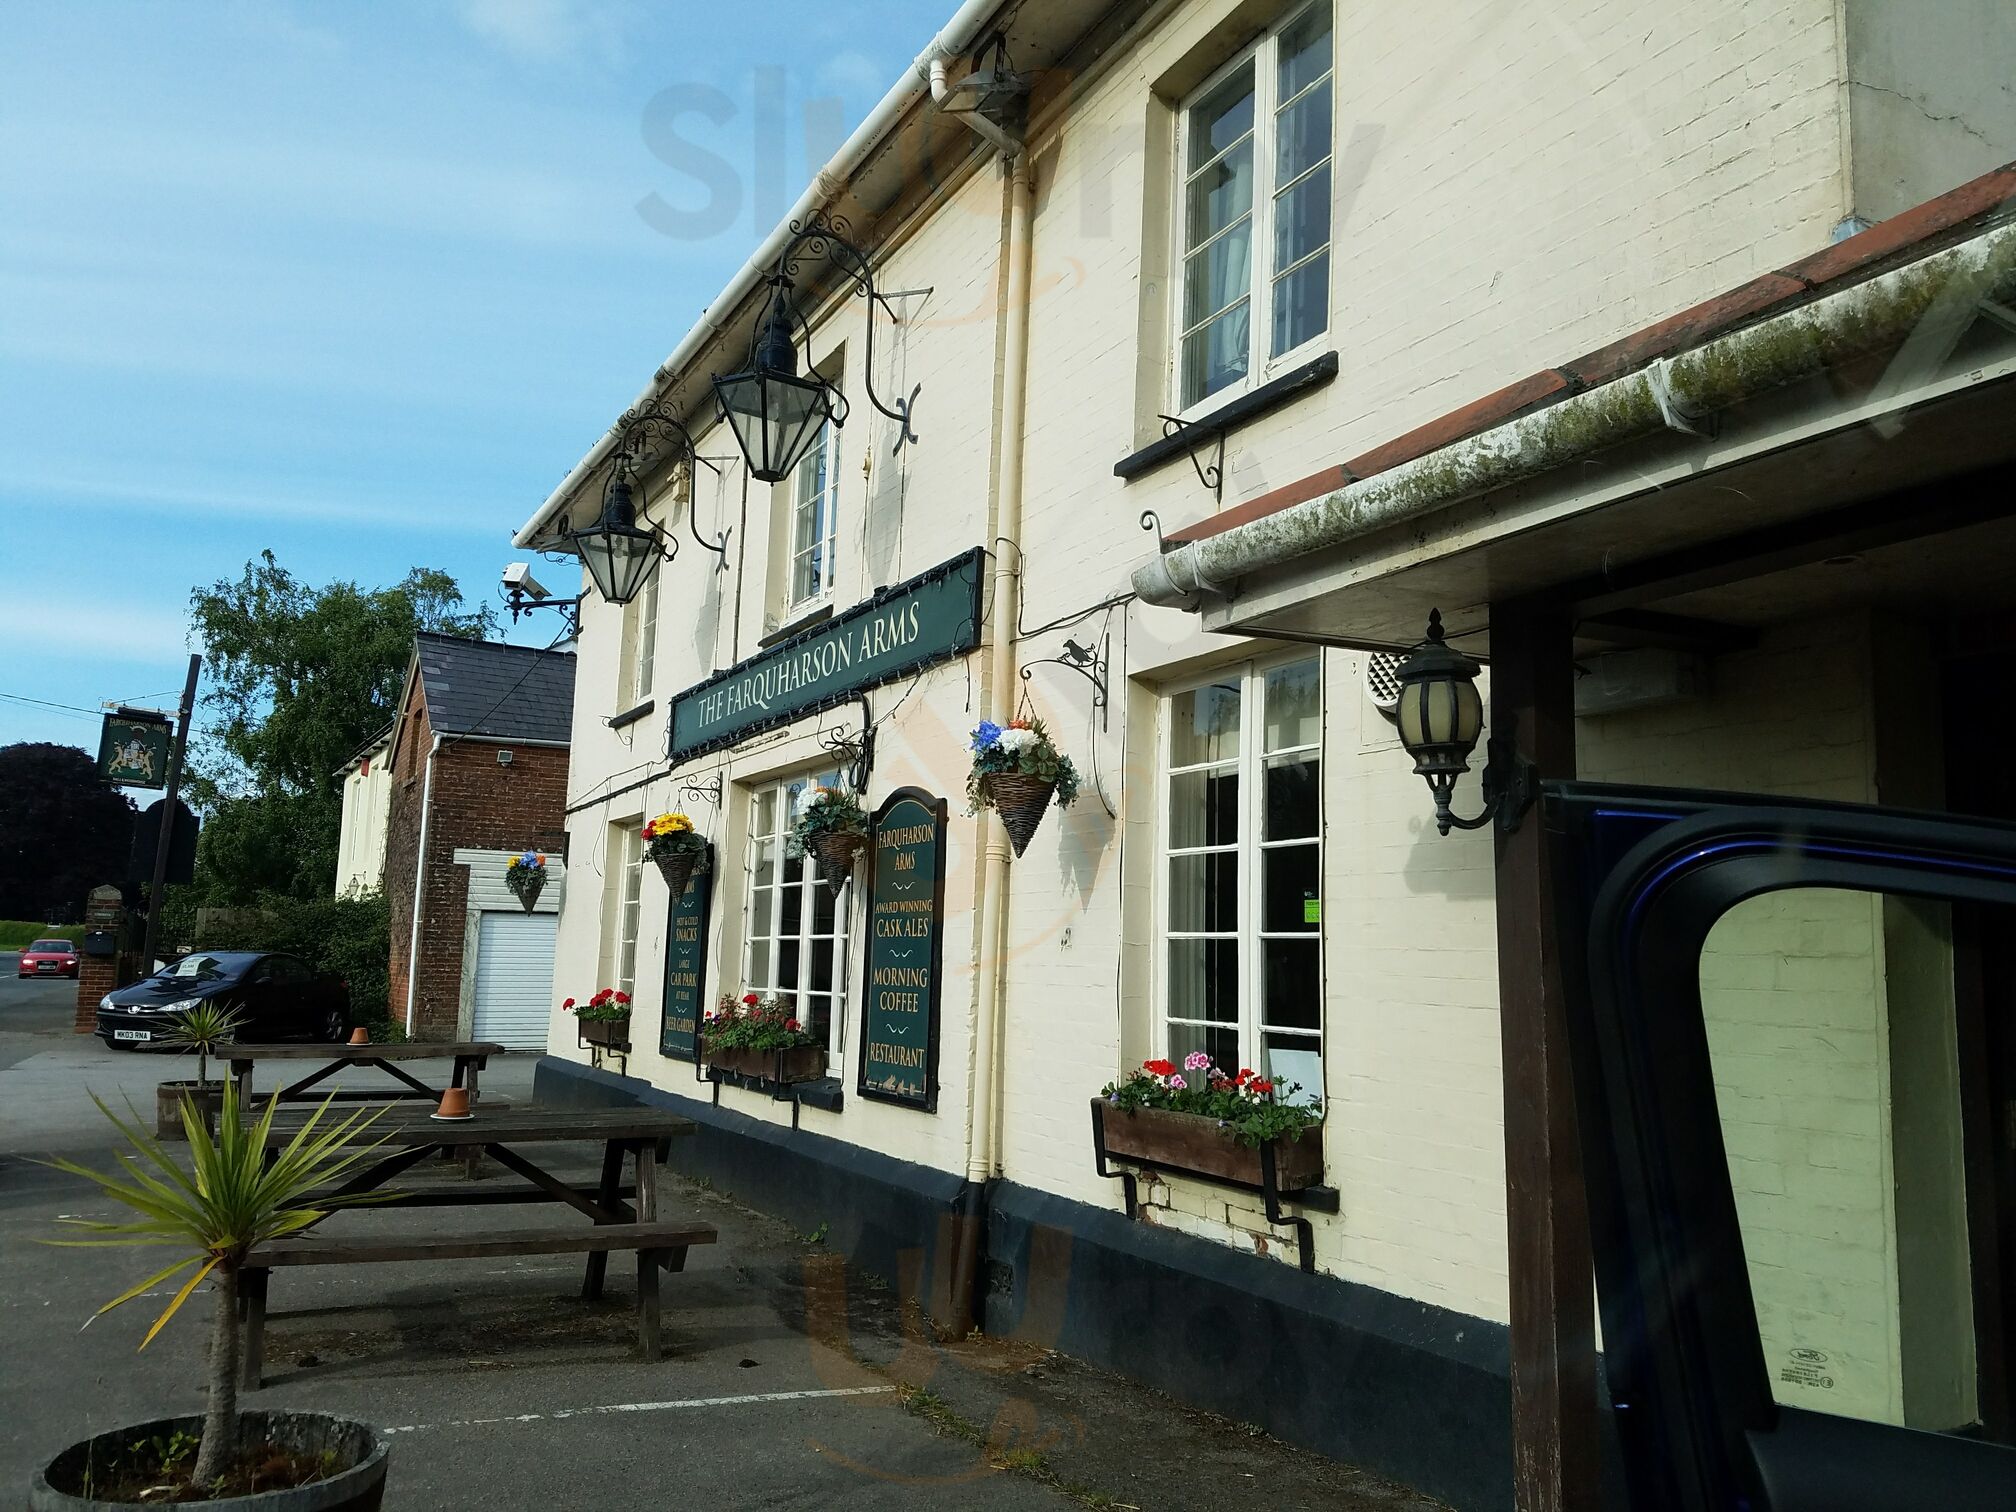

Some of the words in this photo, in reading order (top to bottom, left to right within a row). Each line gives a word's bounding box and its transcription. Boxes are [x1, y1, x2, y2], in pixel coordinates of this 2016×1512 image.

[698, 694, 723, 728] THE
[726, 632, 852, 716] FARQUHARSON
[858, 601, 920, 663] ARMS
[878, 823, 934, 851] FARQUHARSON
[894, 851, 916, 870] ARMS
[875, 901, 899, 914] AWARD
[899, 899, 933, 914] WINNING
[676, 917, 685, 926] HOT
[688, 916, 699, 926] COLD
[876, 918, 904, 938] CASK
[905, 917, 929, 937] ALES
[675, 928, 697, 942] SNACKS
[670, 972, 682, 986] CAR
[682, 973, 697, 988] PARK
[873, 967, 928, 988] MORNING
[879, 991, 919, 1013] COFFEE
[666, 1016, 676, 1031] BEER
[676, 1018, 696, 1034] GARDEN
[117, 1031, 134, 1039] MK03
[134, 1031, 148, 1039] RNA
[869, 1042, 925, 1069] RESTAURANT
